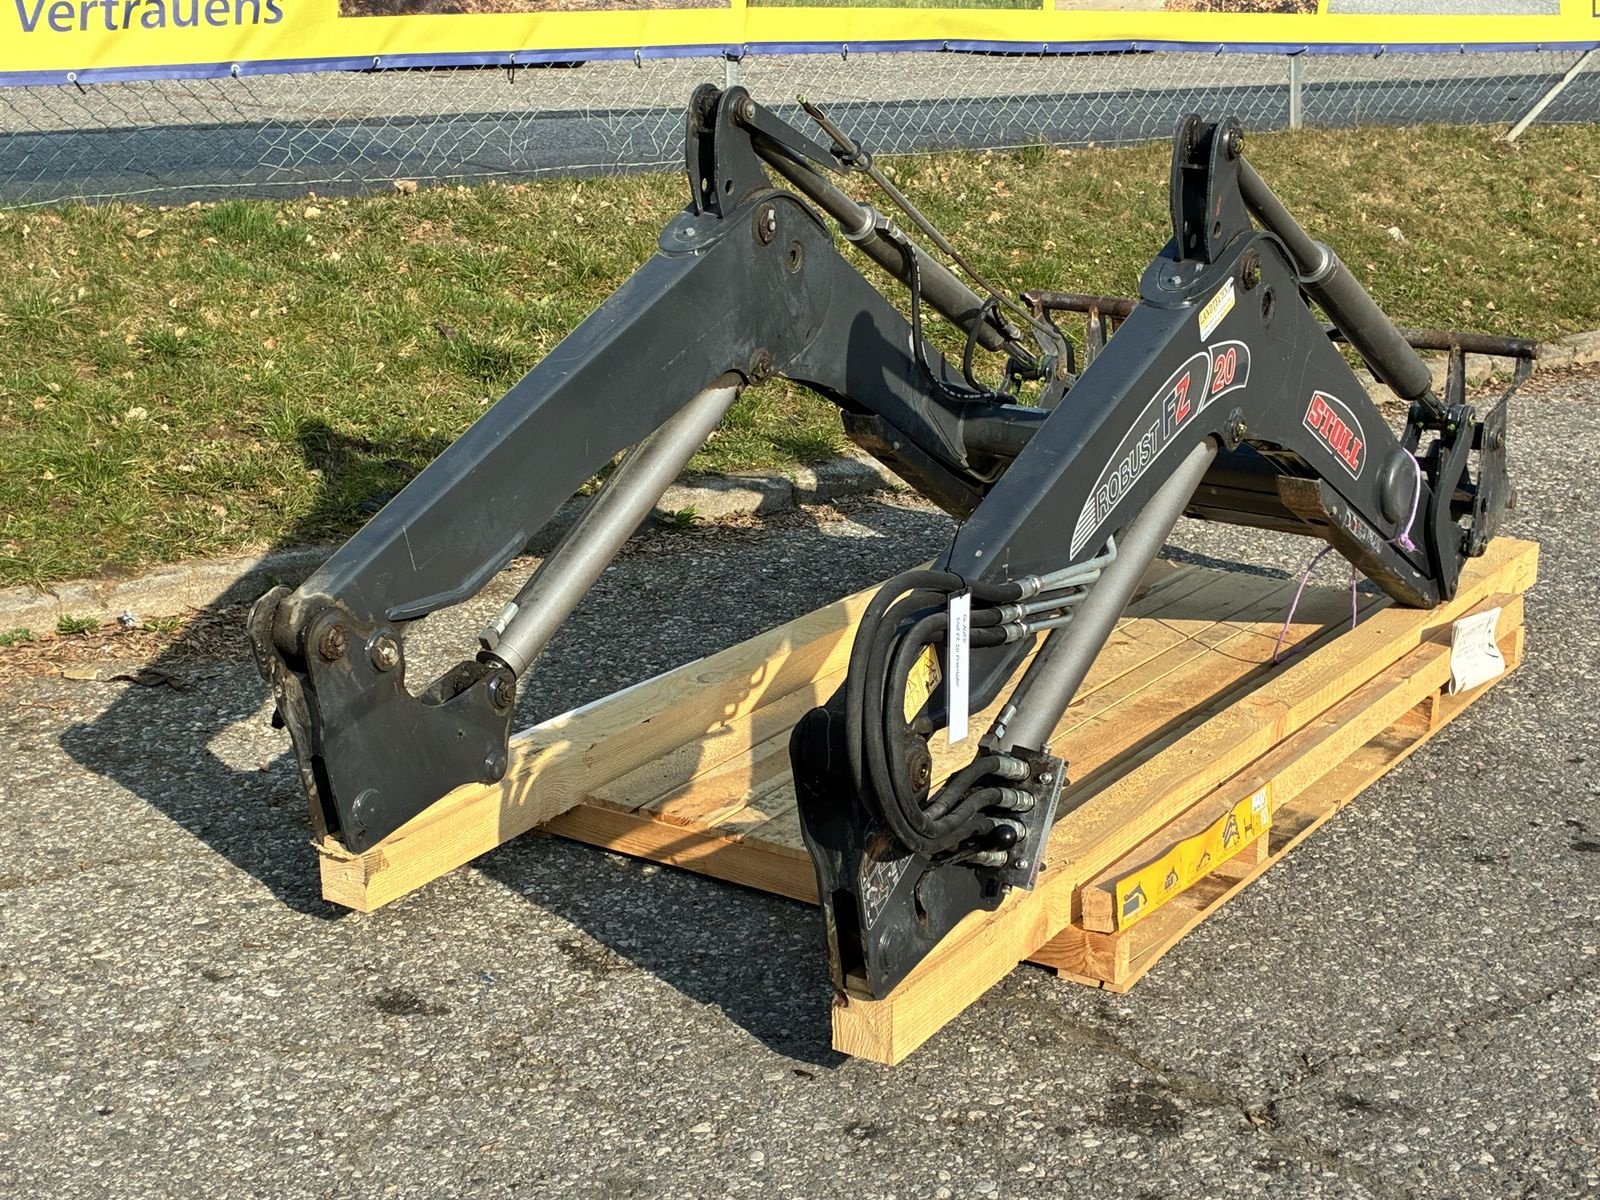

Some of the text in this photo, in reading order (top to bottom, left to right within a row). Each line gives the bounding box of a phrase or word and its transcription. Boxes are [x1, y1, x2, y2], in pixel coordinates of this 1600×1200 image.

[14, 0, 285, 33] Vertrauens
[1094, 418, 1161, 523] ROBUST
[1162, 371, 1191, 441] FZ
[1211, 347, 1237, 395] 20
[1306, 394, 1364, 472] STOLL
